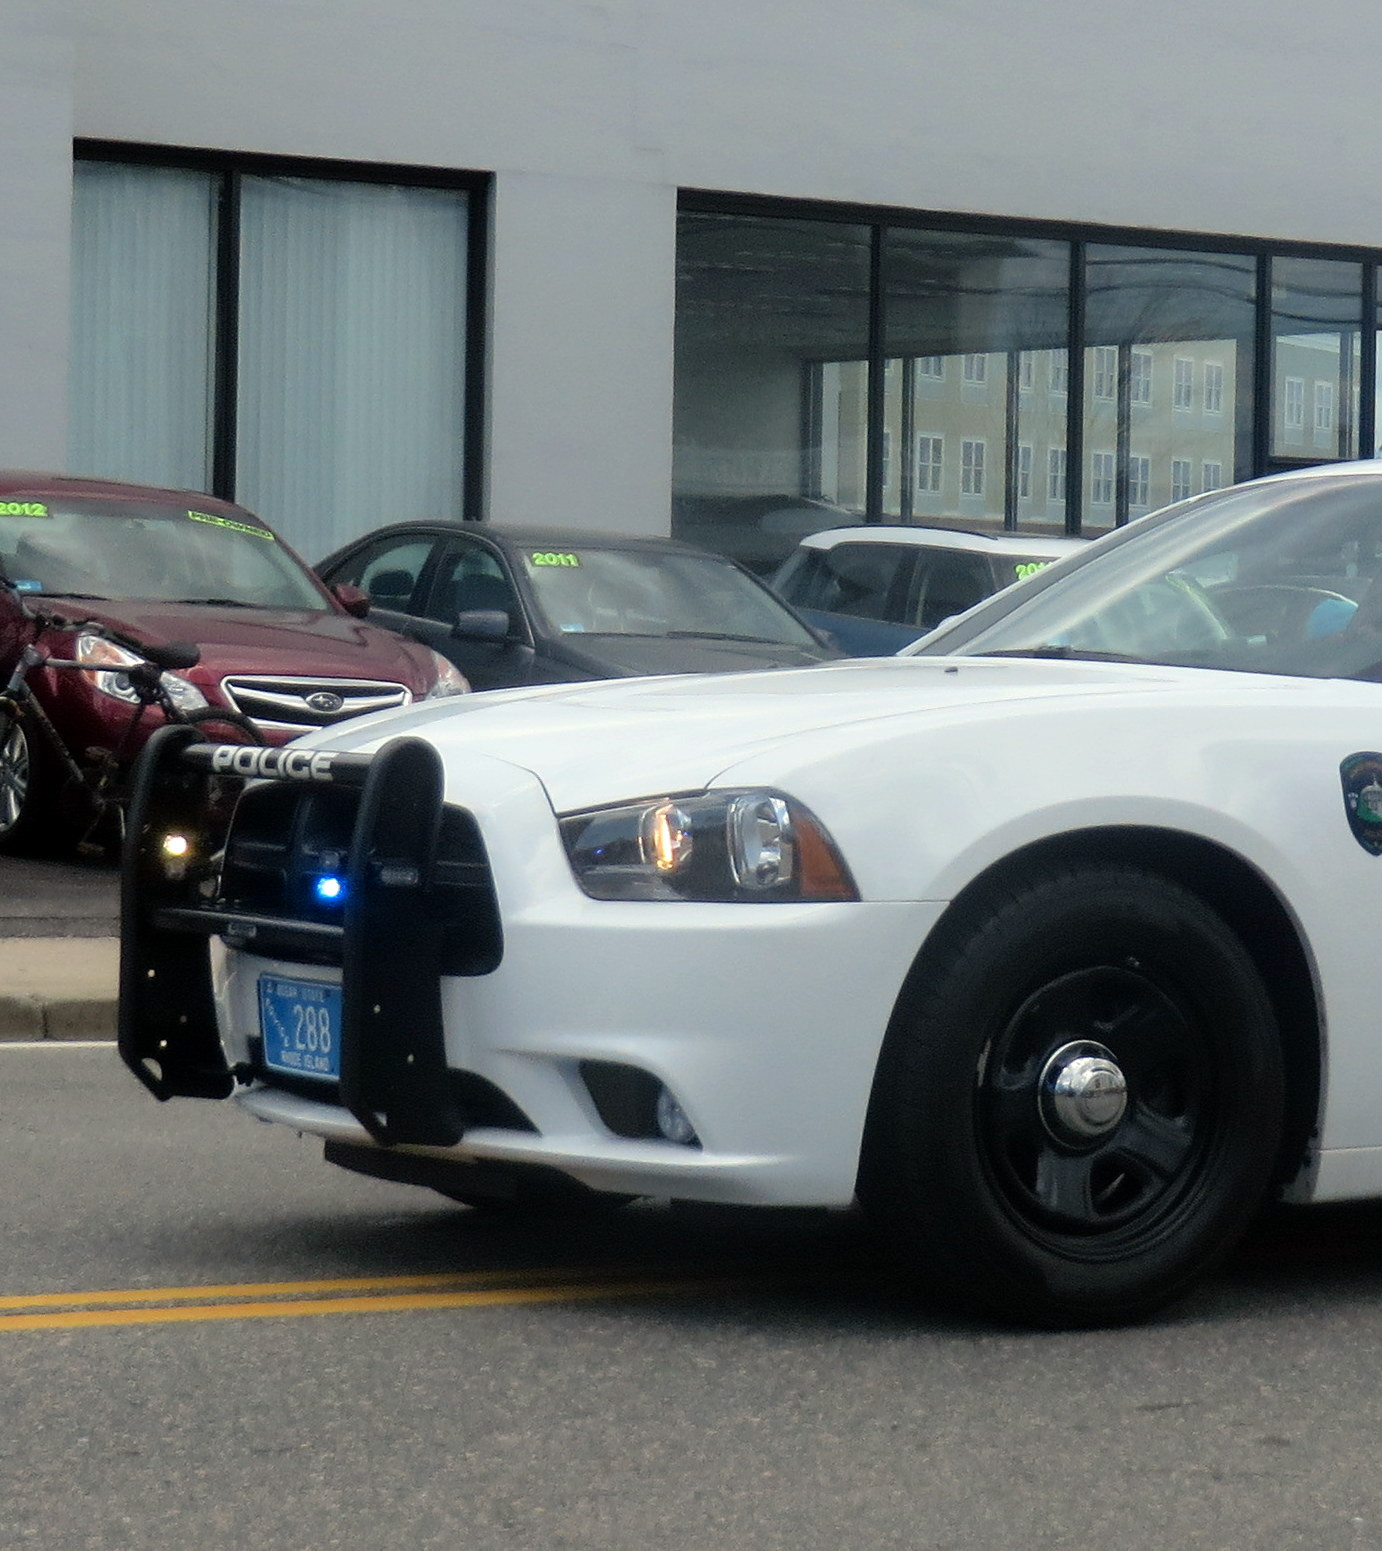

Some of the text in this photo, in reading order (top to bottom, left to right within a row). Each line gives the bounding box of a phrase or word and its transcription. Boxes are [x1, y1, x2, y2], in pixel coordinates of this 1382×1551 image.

[0, 502, 48, 517] 2012
[532, 552, 579, 567] 2011
[212, 745, 339, 781] POLICE
[293, 1003, 332, 1054] 288
